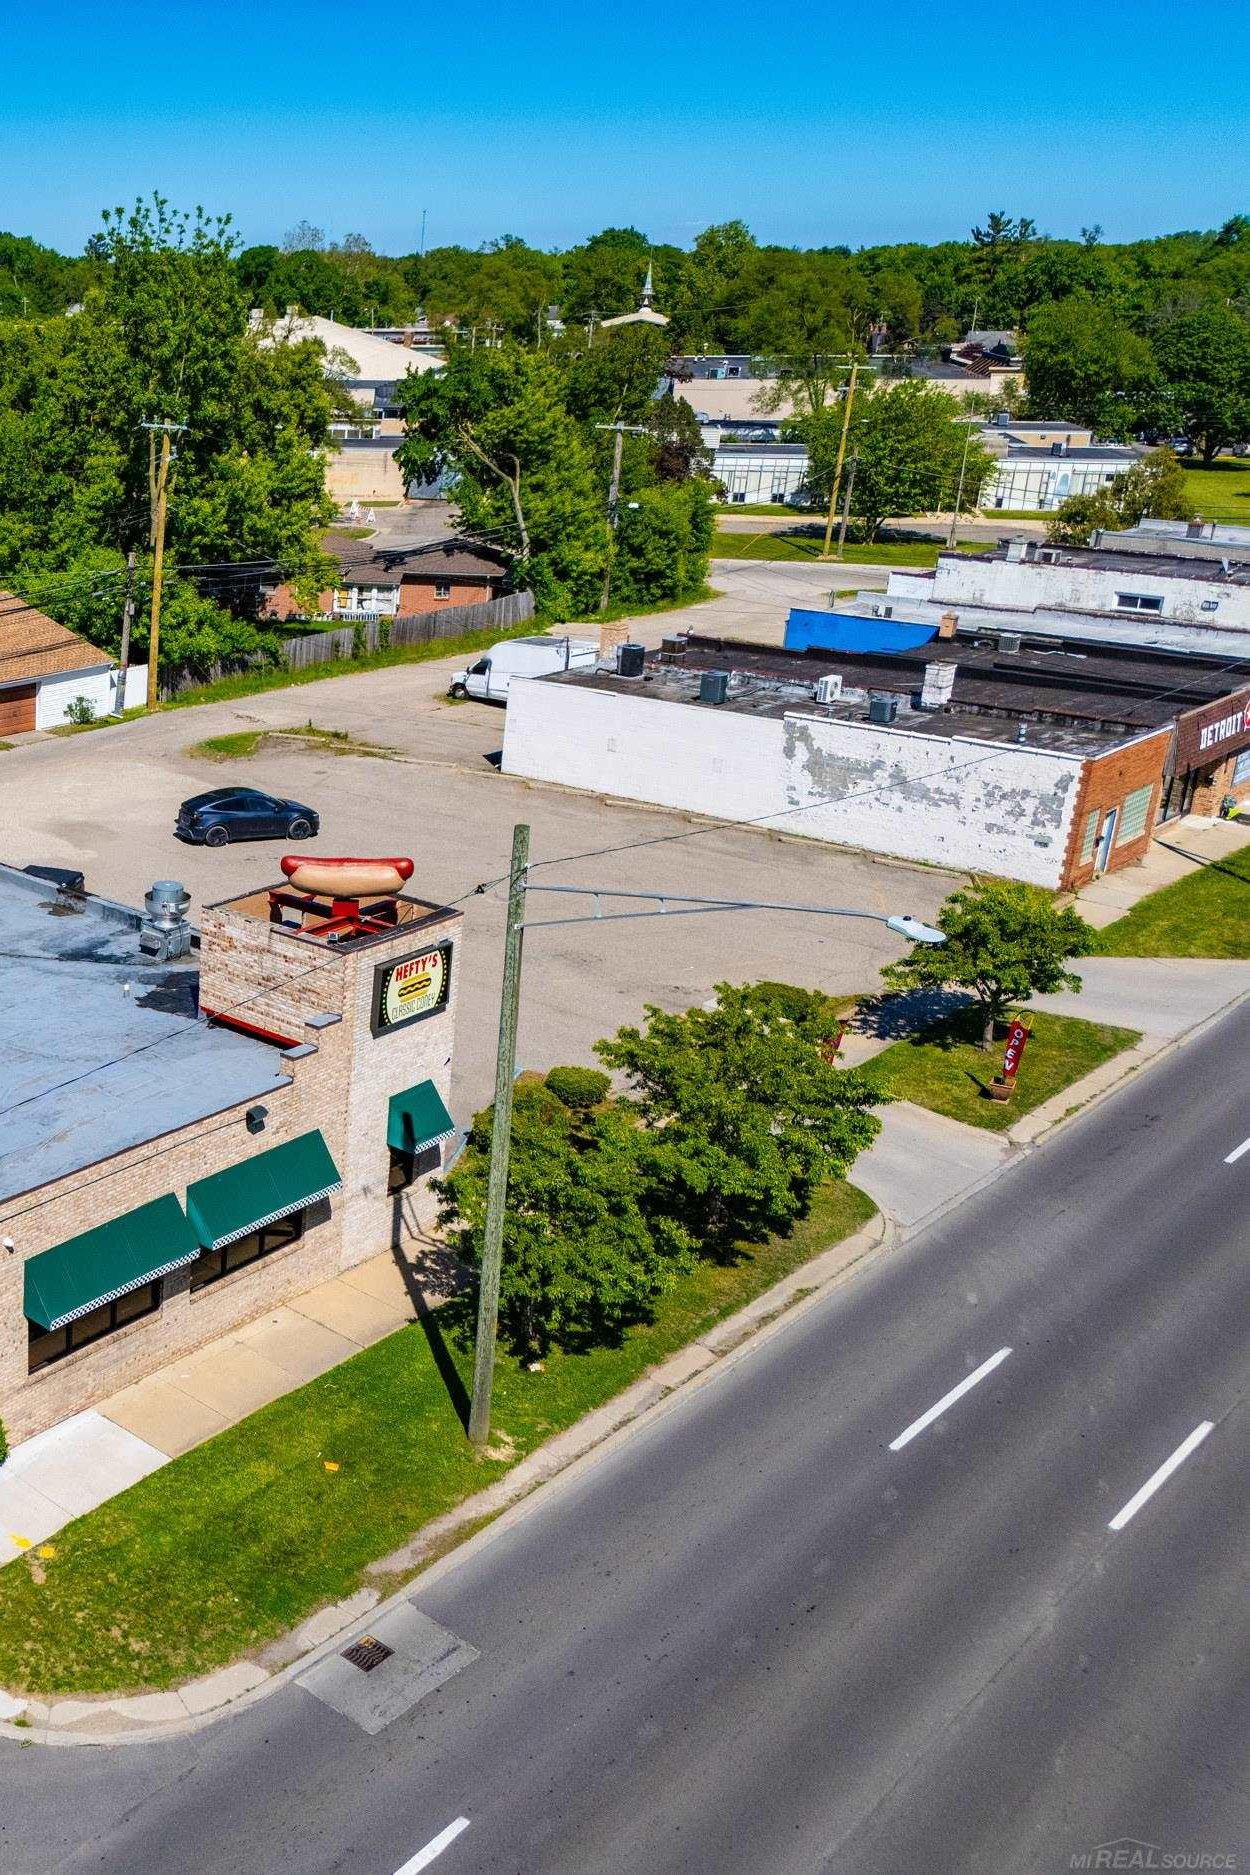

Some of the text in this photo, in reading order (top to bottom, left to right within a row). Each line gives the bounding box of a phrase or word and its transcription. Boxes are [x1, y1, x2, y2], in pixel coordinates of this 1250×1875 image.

[1199, 711, 1243, 750] DETROIT
[395, 953, 438, 982] HEFTY'S
[391, 1000, 415, 1020] CLASSIC
[1004, 1028, 1023, 1071] OPEN
